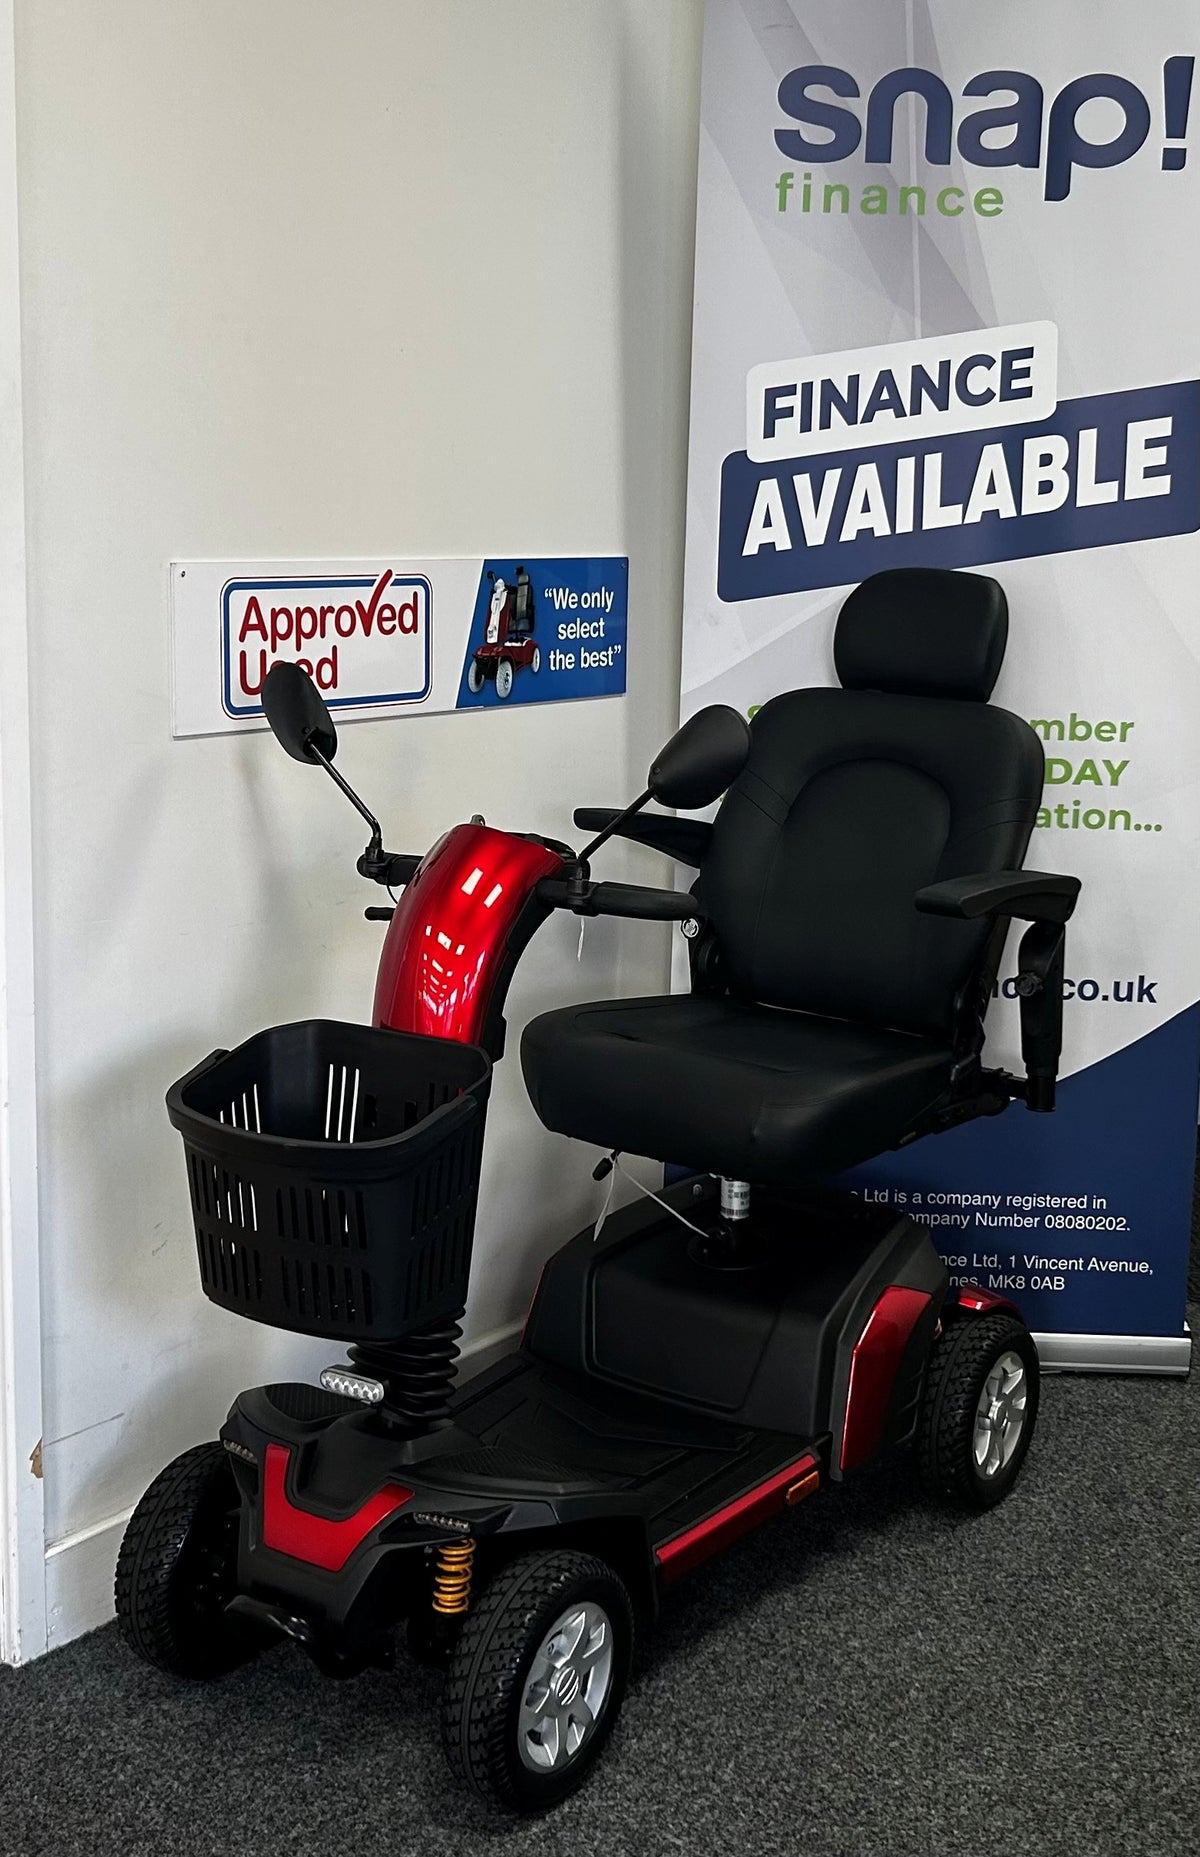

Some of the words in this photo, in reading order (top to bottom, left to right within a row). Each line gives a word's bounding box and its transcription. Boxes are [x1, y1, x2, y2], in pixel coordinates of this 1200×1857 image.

[773, 55, 1196, 202] snap!
[774, 172, 1005, 217] finance
[762, 346, 1035, 439] FINANCE
[740, 416, 1173, 556] AVAILABLE
[238, 569, 419, 653] Approved
[580, 586, 614, 613] only
[557, 617, 605, 640] select
[239, 645, 338, 696] Ud
[549, 648, 576, 671] the
[1029, 712, 1135, 742] mber
[1044, 757, 1131, 786] DAY
[1034, 799, 1162, 832] ation...
[864, 1188, 889, 1203] Ltd
[894, 1188, 907, 1204] is
[911, 1192, 922, 1204] a
[927, 1192, 1001, 1210] company
[1006, 1193, 1088, 1211] registered
[1092, 1194, 1107, 1210] in
[908, 1213, 970, 1229] mpany
[975, 1211, 1041, 1228] Number
[1044, 1214, 1131, 1231] 08080202.
[972, 1253, 1002, 1270] Ltd,
[1009, 1254, 1016, 1268] 1
[1023, 1254, 1084, 1271] Vincent
[1087, 1256, 1154, 1275] Avenue,
[988, 1274, 1026, 1290] MK8
[1030, 1276, 1066, 1290] 0AB
